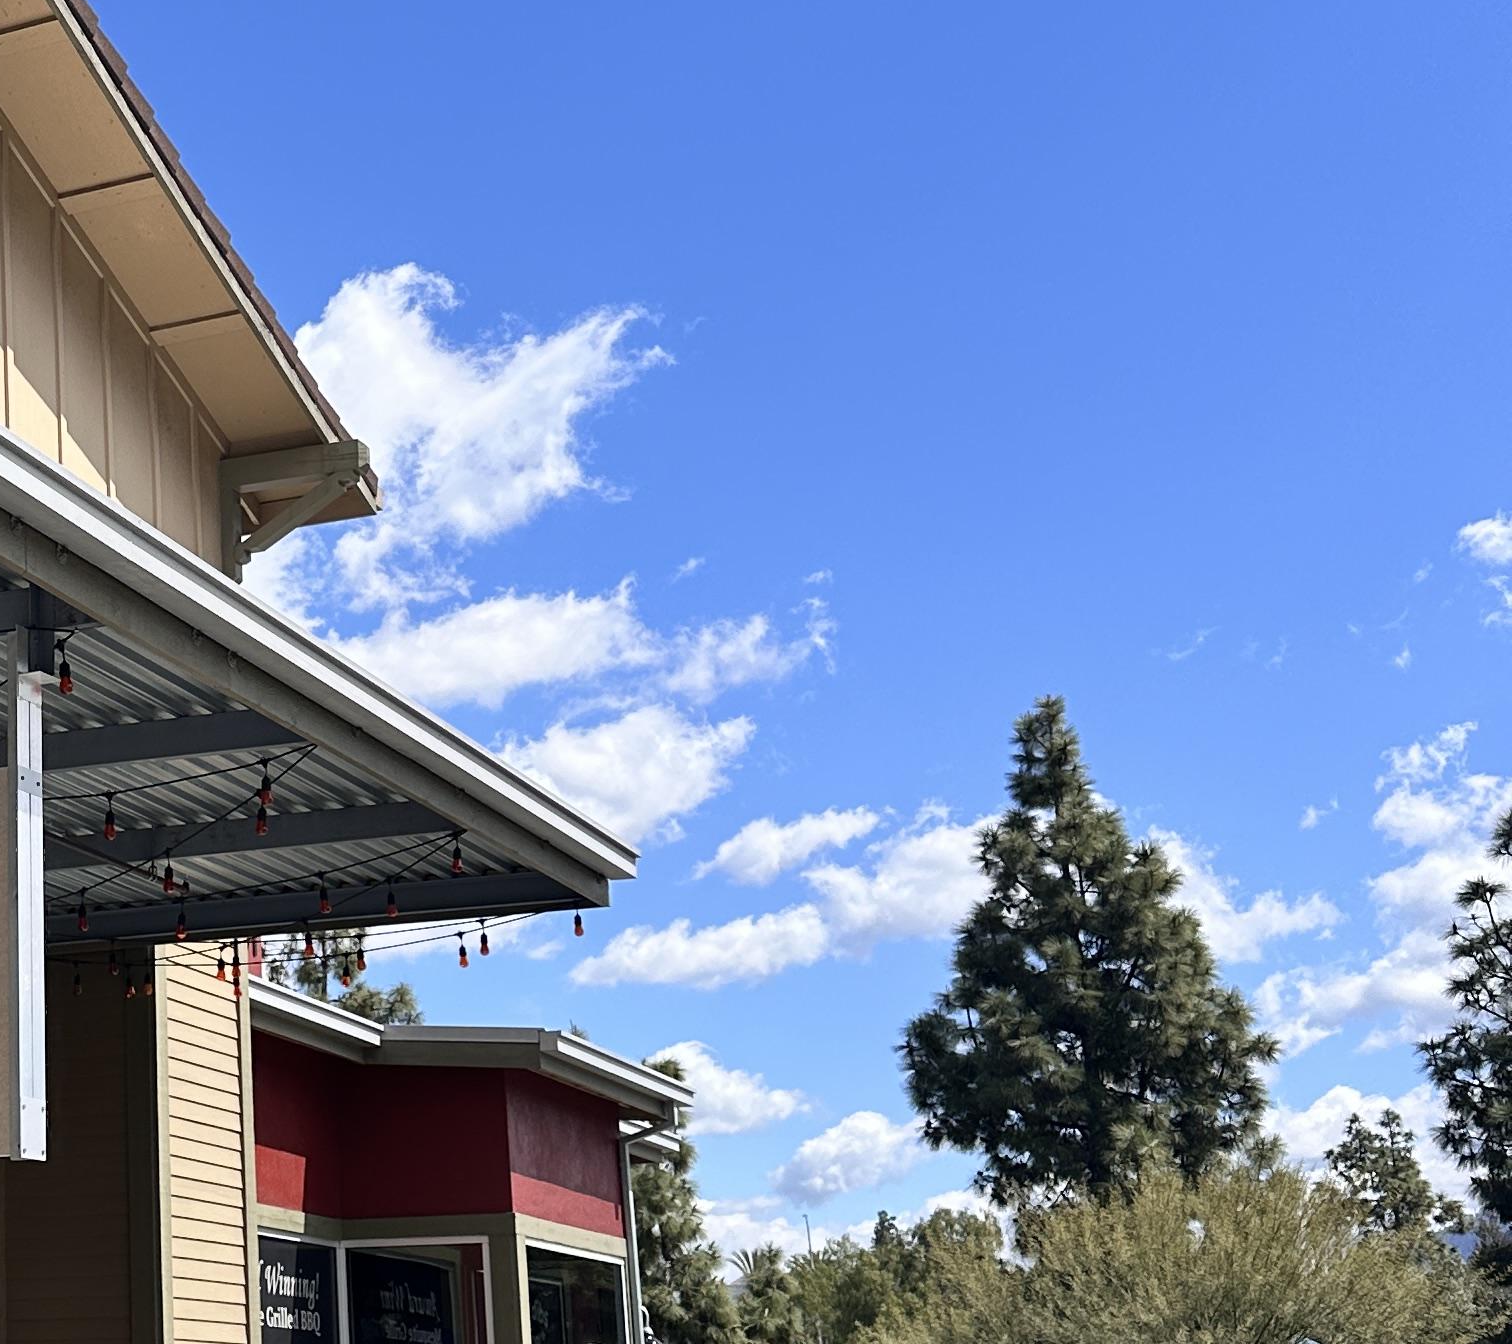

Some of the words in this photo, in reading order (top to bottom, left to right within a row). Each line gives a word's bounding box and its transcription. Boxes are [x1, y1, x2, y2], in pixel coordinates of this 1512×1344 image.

[265, 1261, 320, 1310] Winning!
[266, 1306, 299, 1330] Grilled
[301, 1309, 321, 1337] BBQ
